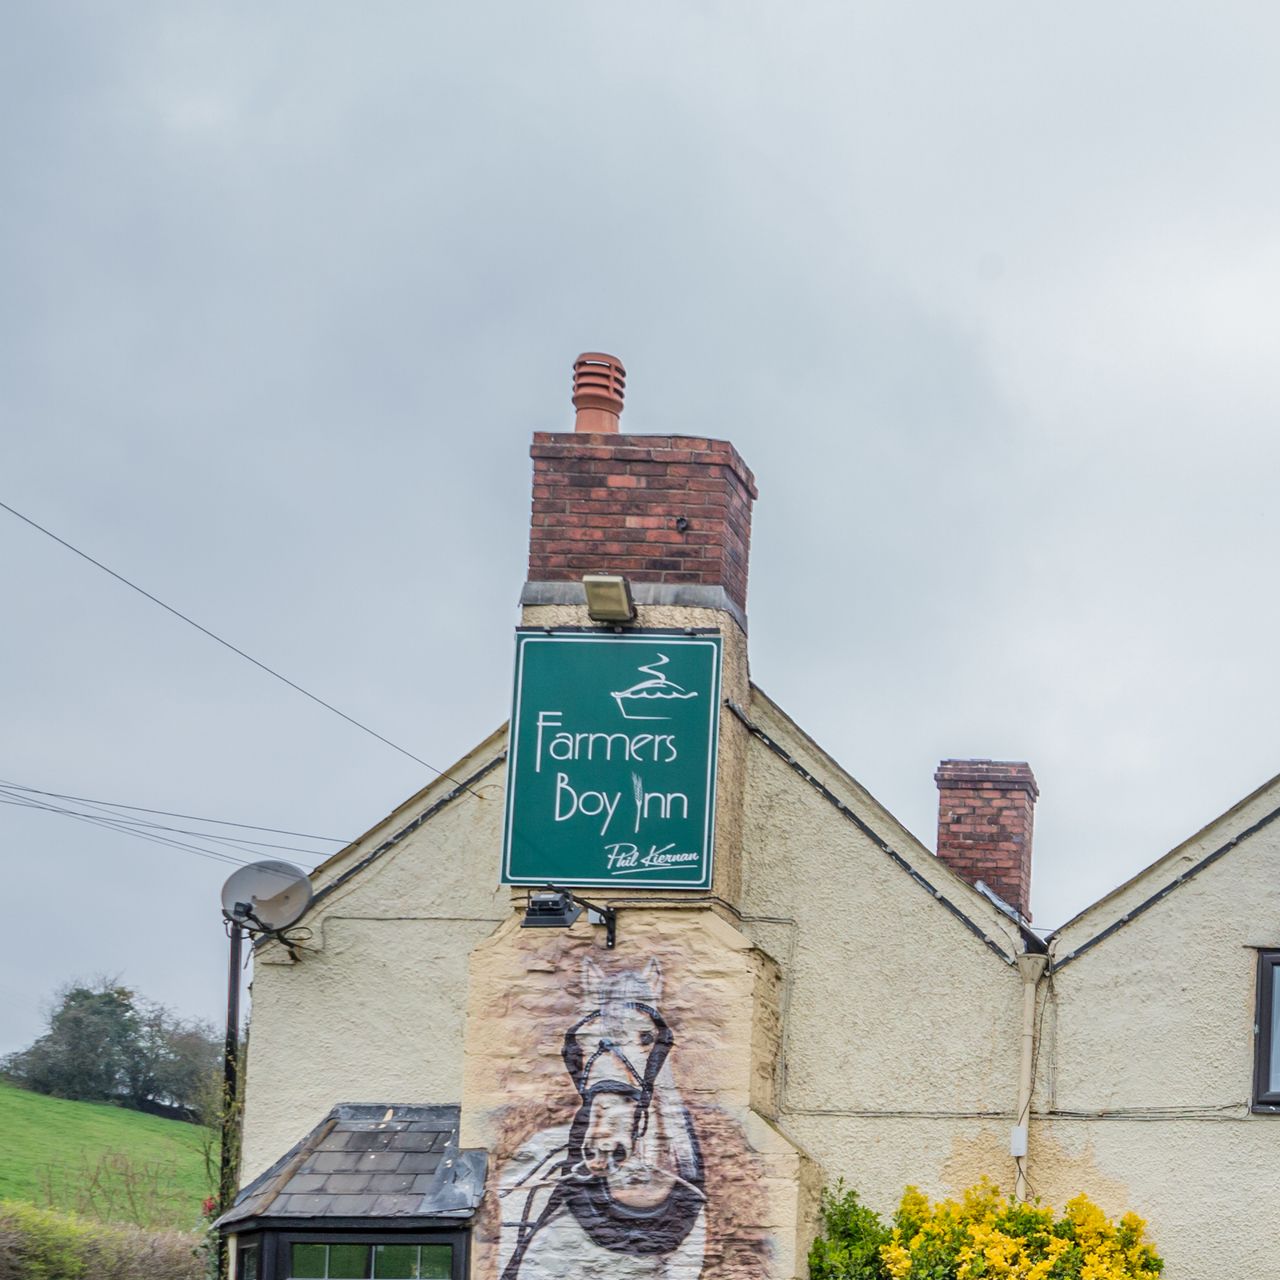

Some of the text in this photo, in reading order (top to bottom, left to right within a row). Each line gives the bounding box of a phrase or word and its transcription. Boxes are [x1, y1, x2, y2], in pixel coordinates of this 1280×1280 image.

[535, 711, 678, 773] Farmers
[554, 771, 688, 836] Boy Inn
[604, 843, 700, 869] Phil Kiernan
